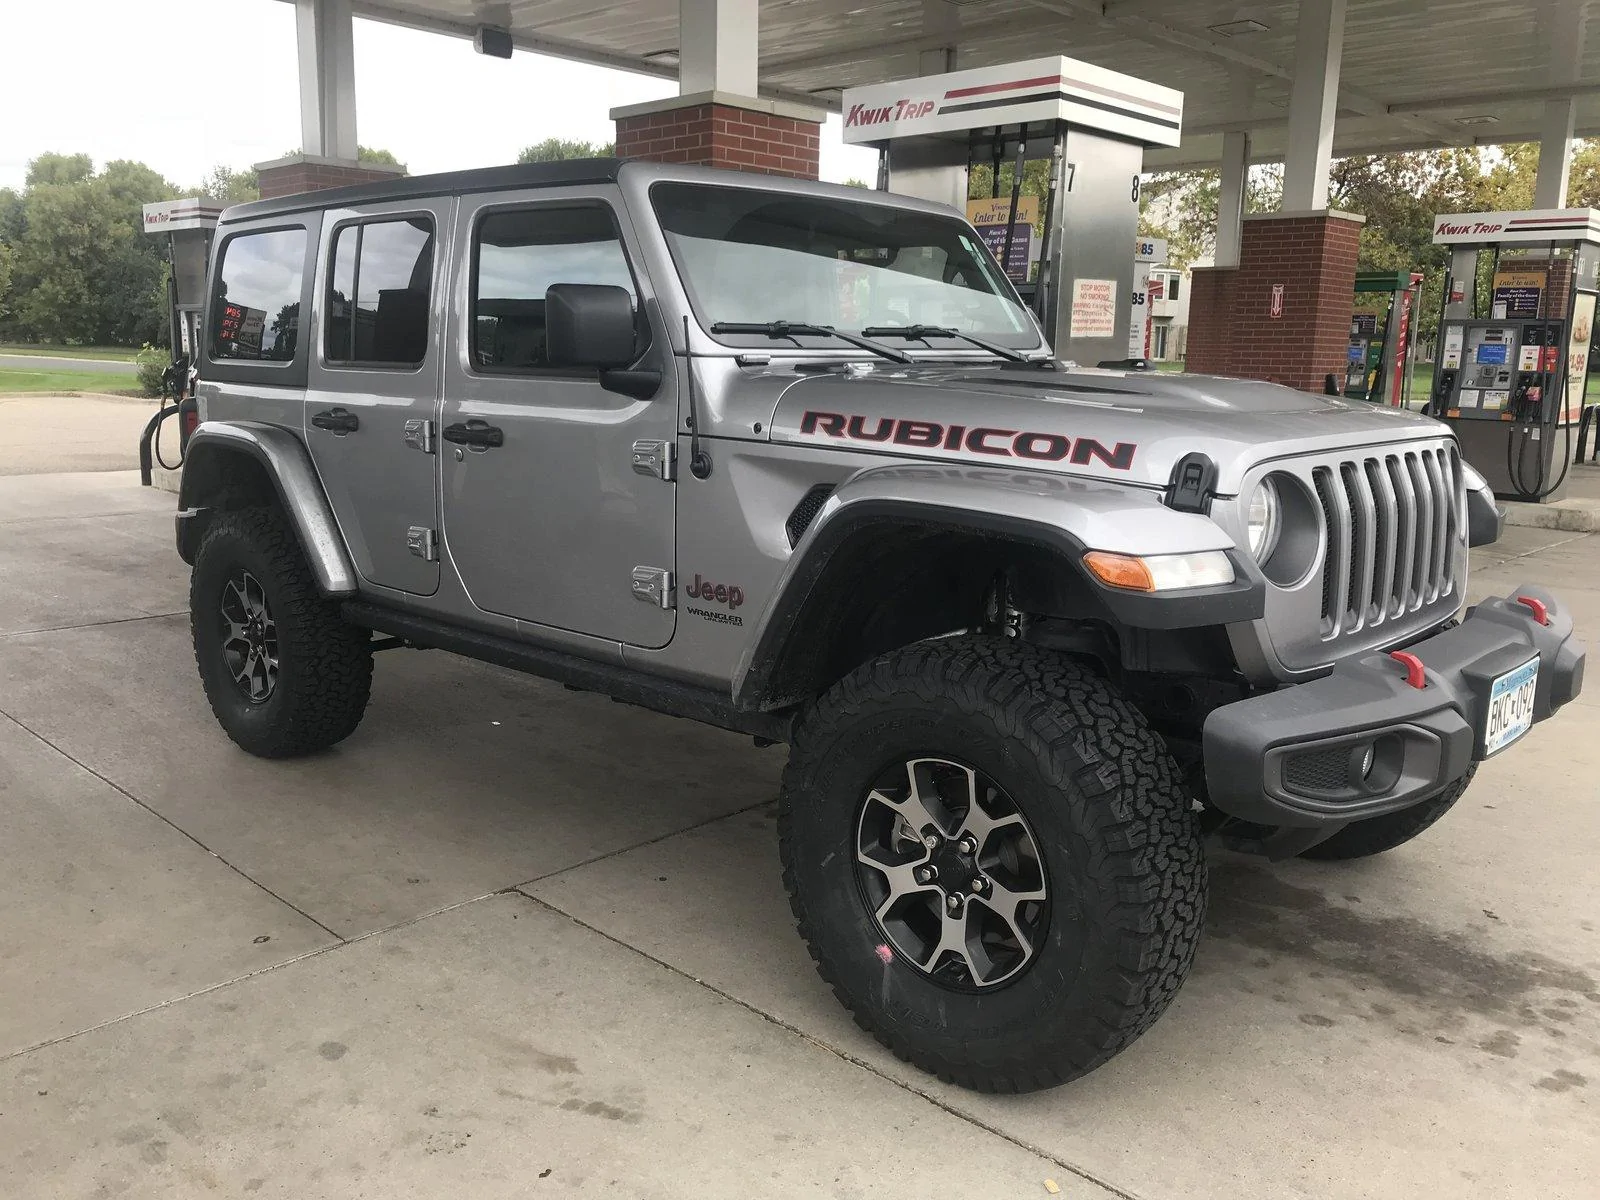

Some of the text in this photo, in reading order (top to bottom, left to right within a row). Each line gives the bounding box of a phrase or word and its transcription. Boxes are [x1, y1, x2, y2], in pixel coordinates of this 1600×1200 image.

[1067, 163, 1076, 193] 7
[1131, 174, 1140, 203] 8
[973, 211, 995, 224] Enter
[999, 236, 1007, 244] th
[800, 410, 1137, 470] RUBICON
[685, 573, 745, 610] Jeep
[687, 606, 743, 623] WRANGLER
